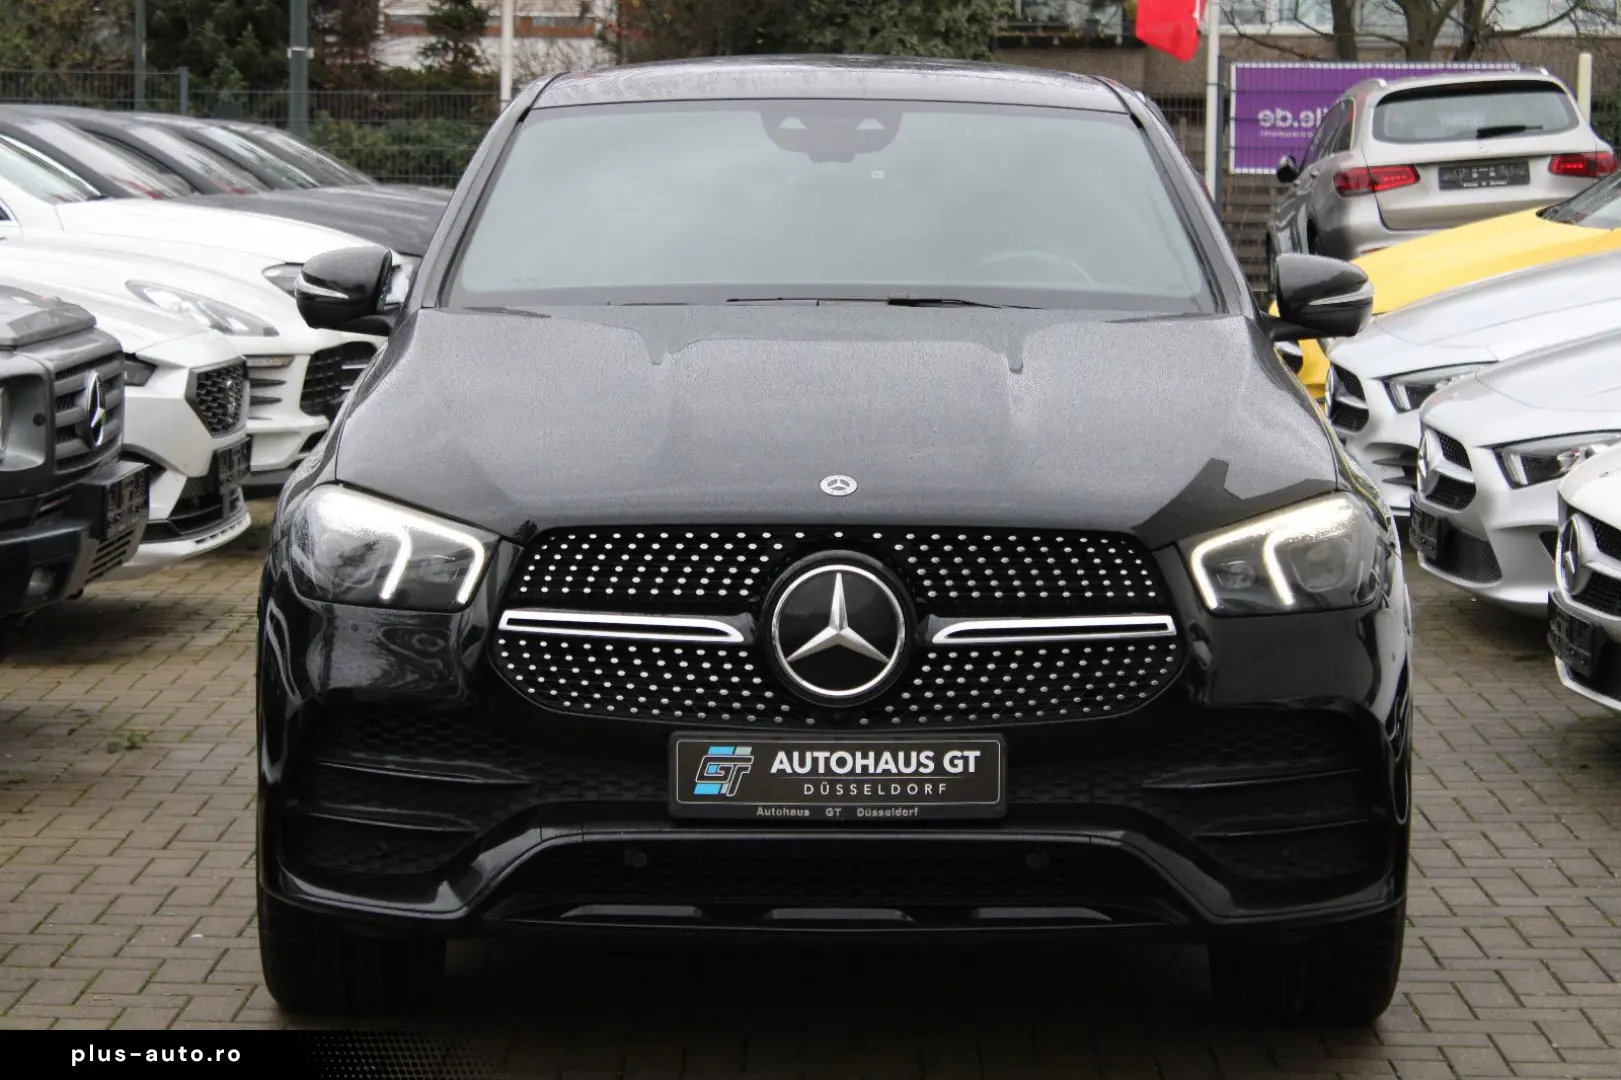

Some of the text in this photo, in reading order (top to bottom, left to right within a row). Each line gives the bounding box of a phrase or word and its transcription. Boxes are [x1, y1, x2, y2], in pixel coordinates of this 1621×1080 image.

[770, 750, 981, 774] AUTOHAUS GT
[803, 781, 947, 796] DÜSSELDORF
[756, 806, 919, 817] Autohaus GT Düsseldorf
